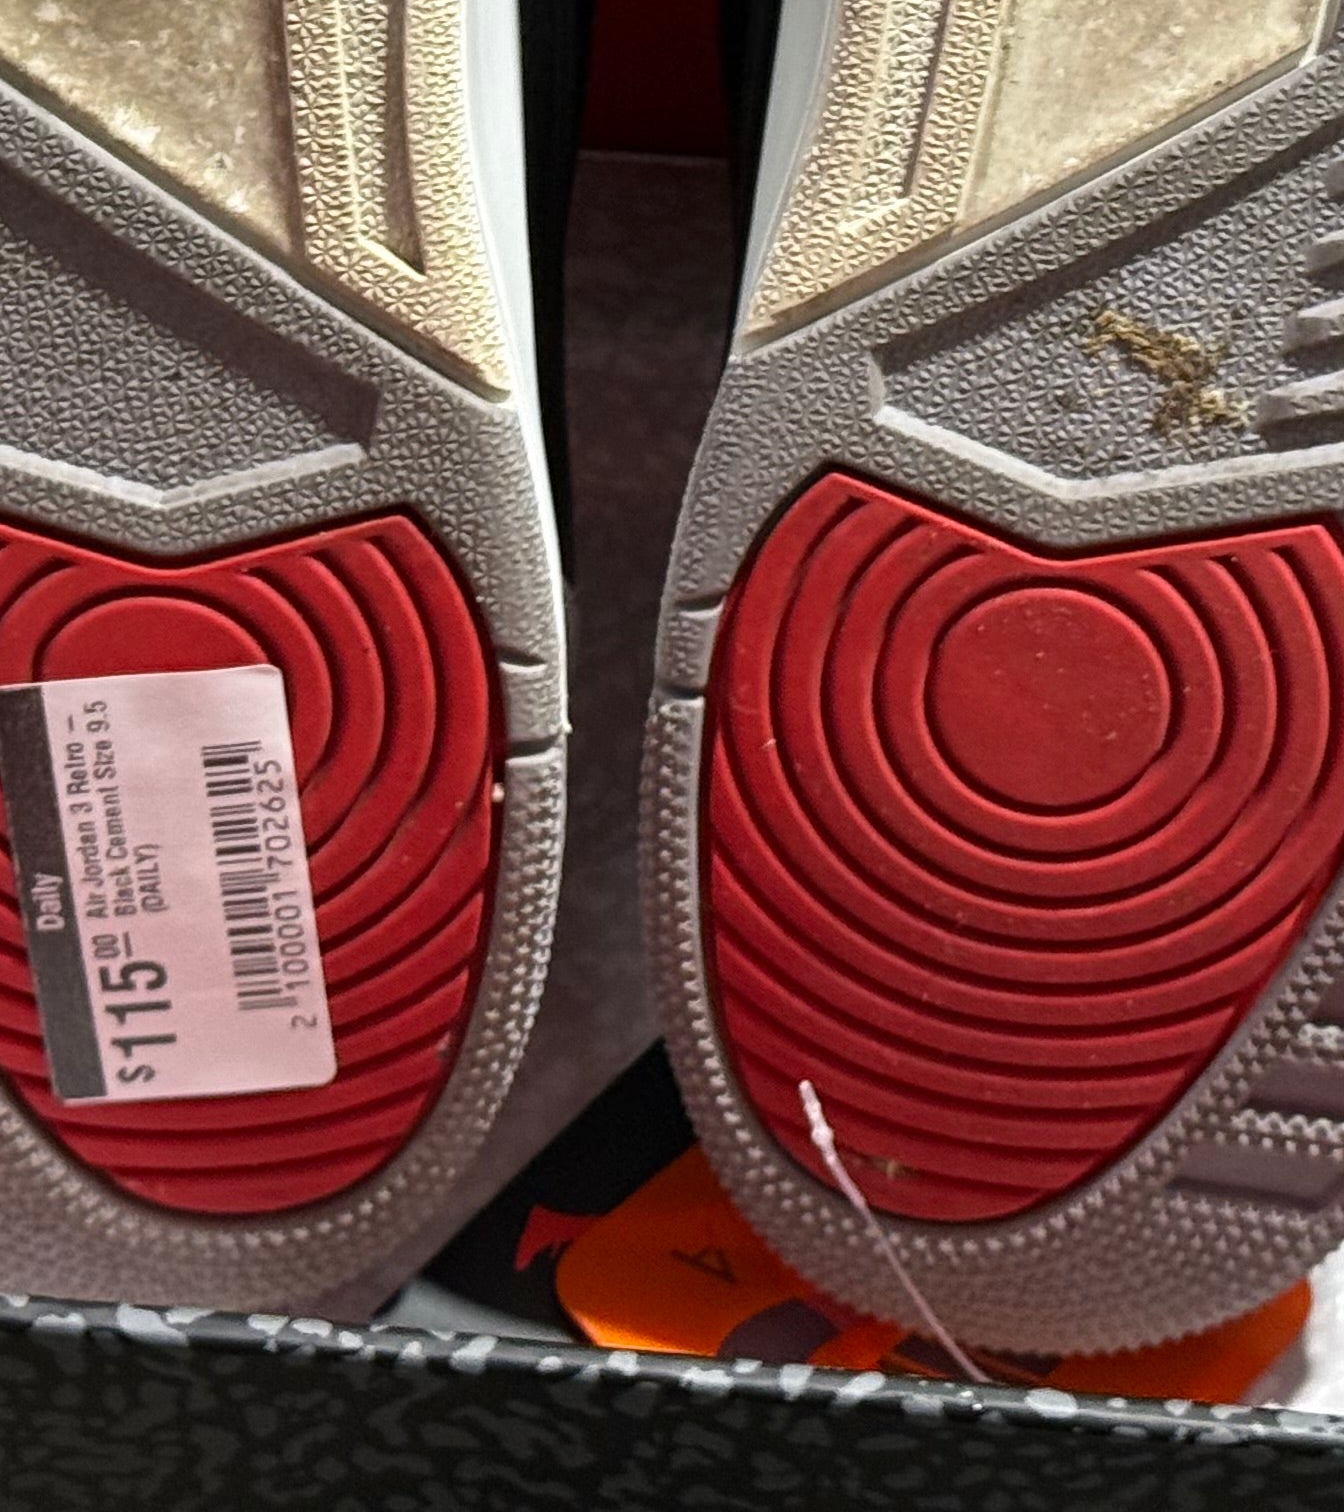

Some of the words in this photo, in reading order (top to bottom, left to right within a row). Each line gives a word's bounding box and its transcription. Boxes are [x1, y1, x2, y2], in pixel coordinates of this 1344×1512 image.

[82, 700, 111, 733] 9.5
[63, 741, 91, 796] Retro
[93, 739, 118, 780] Size
[69, 801, 93, 814] 3
[96, 785, 128, 860] Cement
[76, 821, 105, 888] Jordan
[133, 843, 170, 913] (DAILY)
[31, 872, 65, 931] Daily
[86, 891, 109, 919] Air
[108, 866, 138, 917] Black
